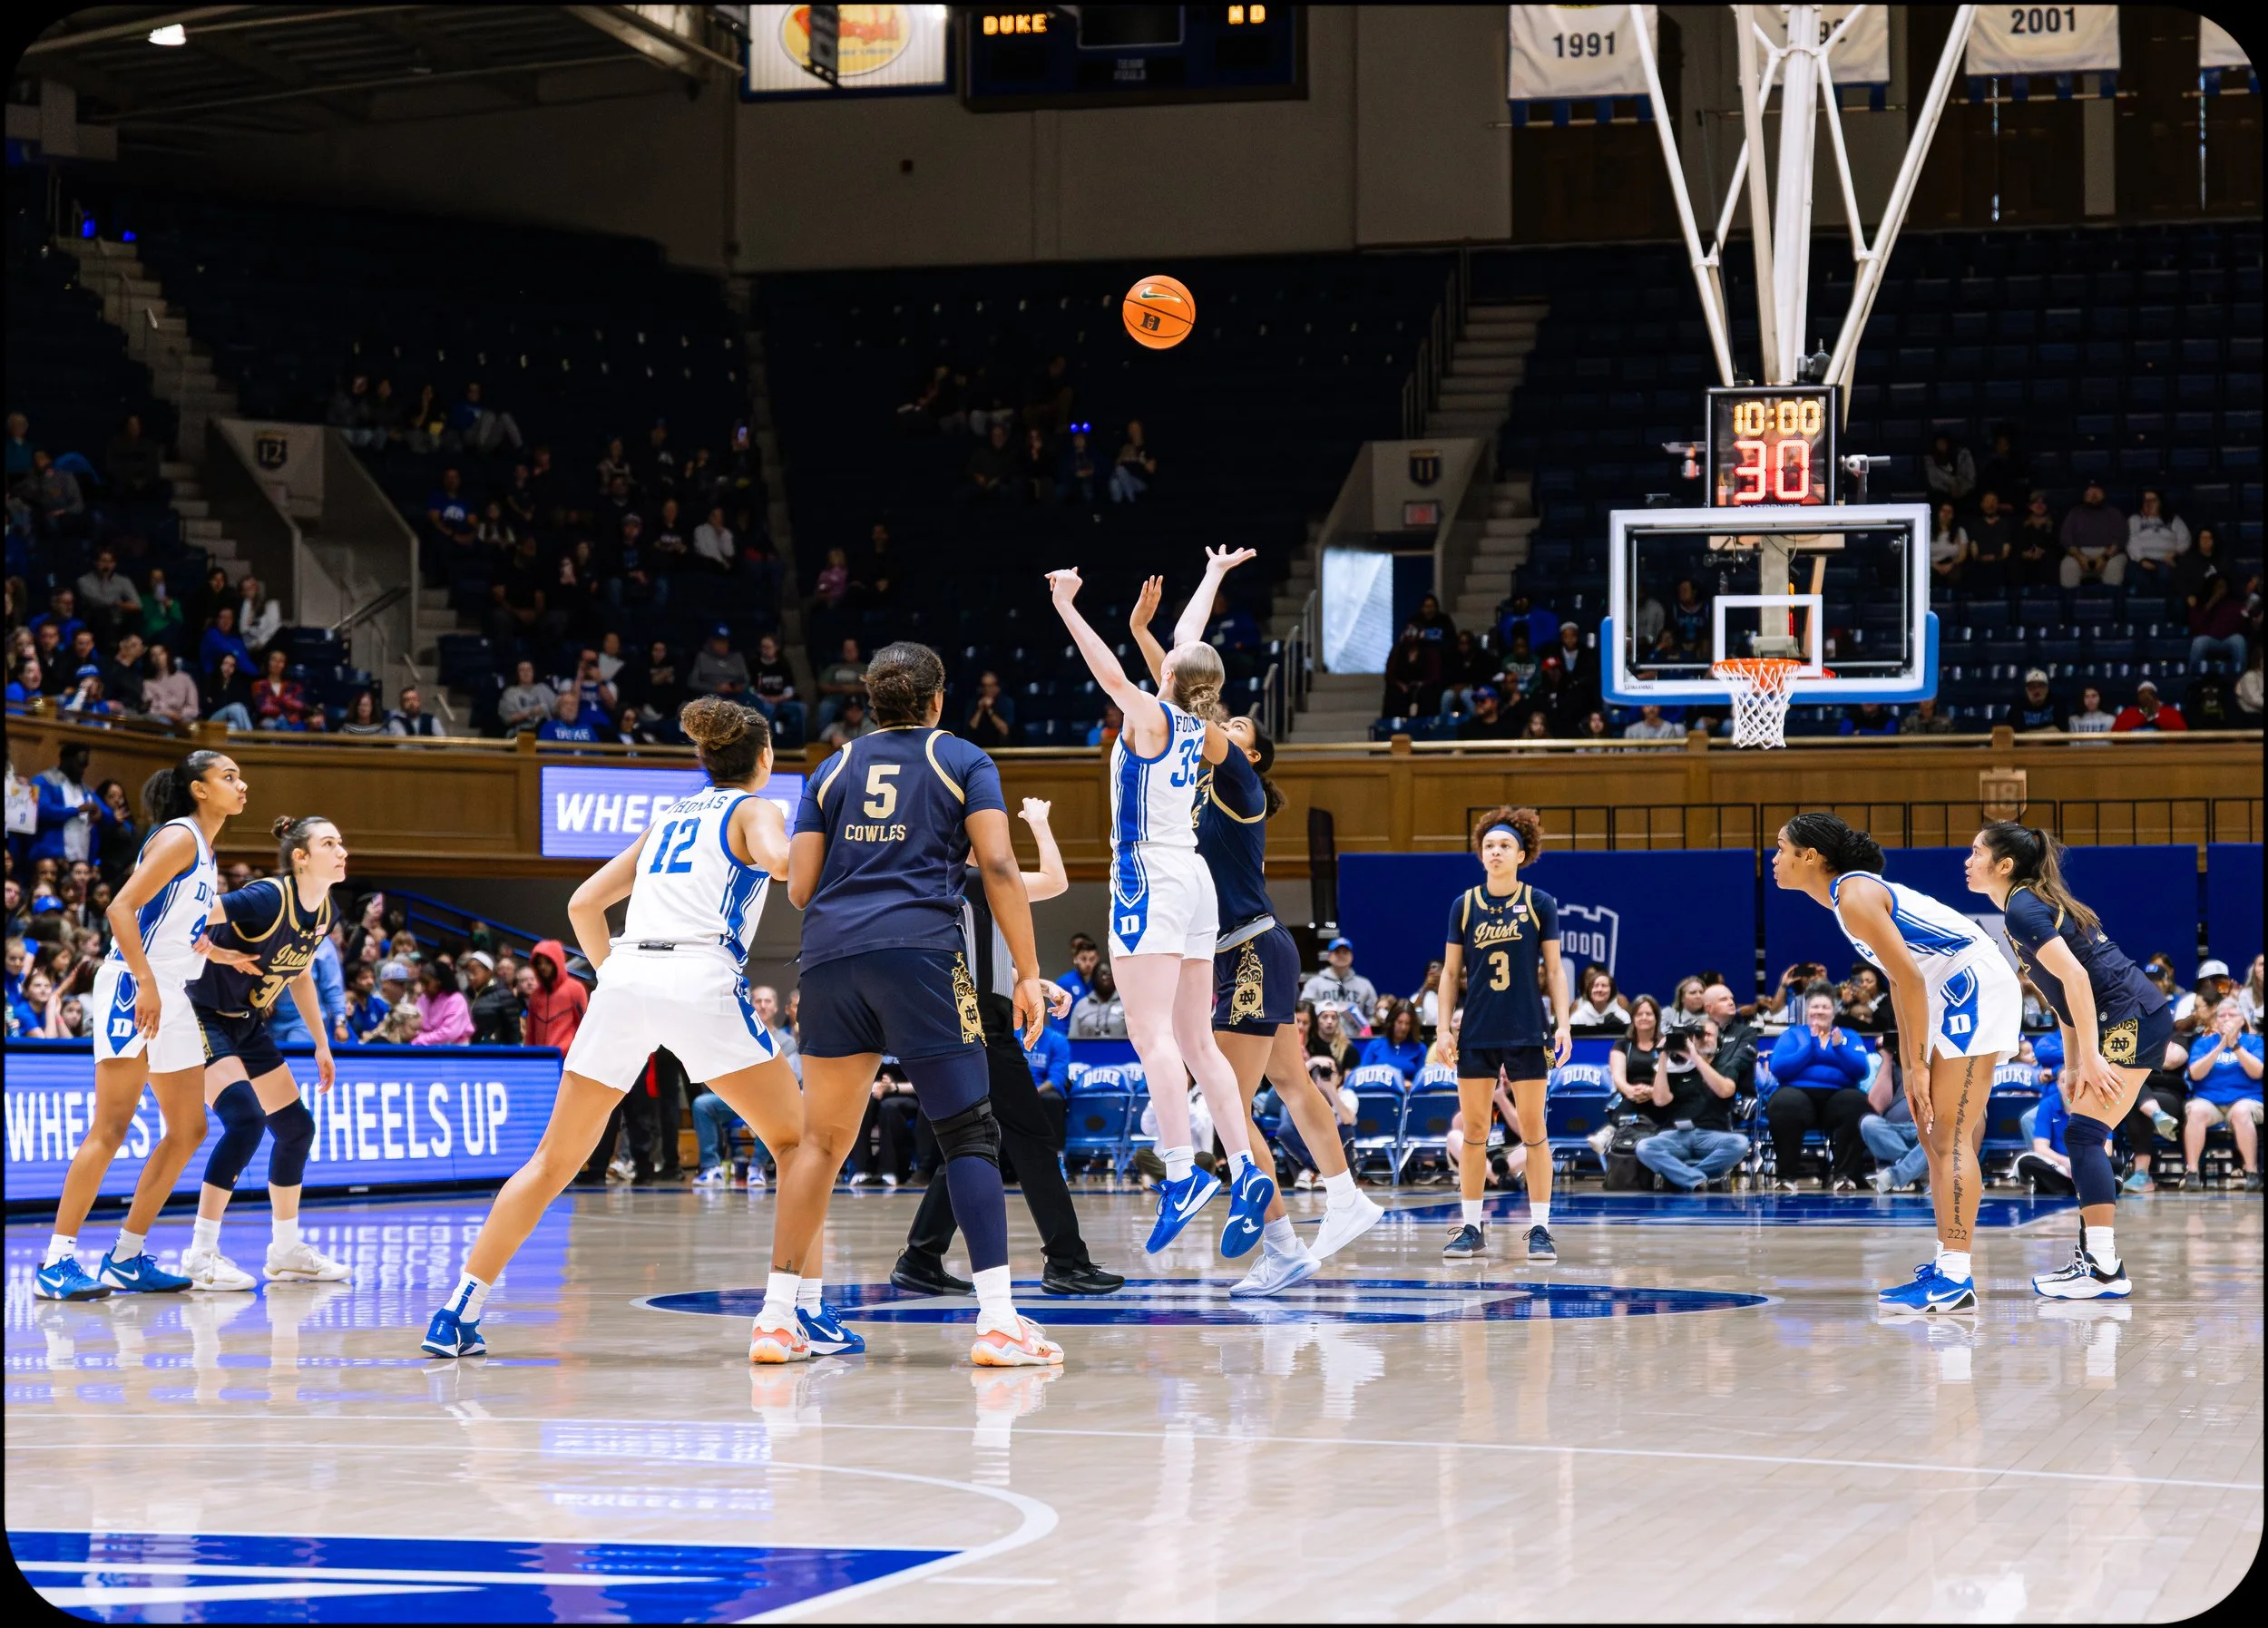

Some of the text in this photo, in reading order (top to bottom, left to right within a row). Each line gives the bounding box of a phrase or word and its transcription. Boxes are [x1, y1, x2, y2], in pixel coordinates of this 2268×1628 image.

[982, 14, 1048, 35] DUKE
[2010, 6, 2076, 34] 2001
[1552, 31, 1616, 58] 1991
[1734, 400, 1821, 436] 10:00
[262, 443, 282, 462] 12
[1733, 439, 1810, 502] 30
[864, 765, 901, 819] 5
[845, 824, 907, 842] COWLES
[649, 817, 701, 874] 12
[1119, 914, 1140, 936] D
[1474, 918, 1523, 949] Irish
[1489, 950, 1510, 991] 3
[1323, 989, 1361, 1004] DUKE
[111, 1018, 133, 1038] D
[1948, 1013, 1971, 1035] D
[1083, 1068, 1121, 1087] DUKE
[1354, 1068, 1394, 1087] DUKE
[1562, 1067, 1602, 1087] DUKE
[1993, 1067, 2032, 1087] DUKE
[301, 1081, 509, 1161] WHEELS UP
[1947, 1227, 1968, 1241] 222
